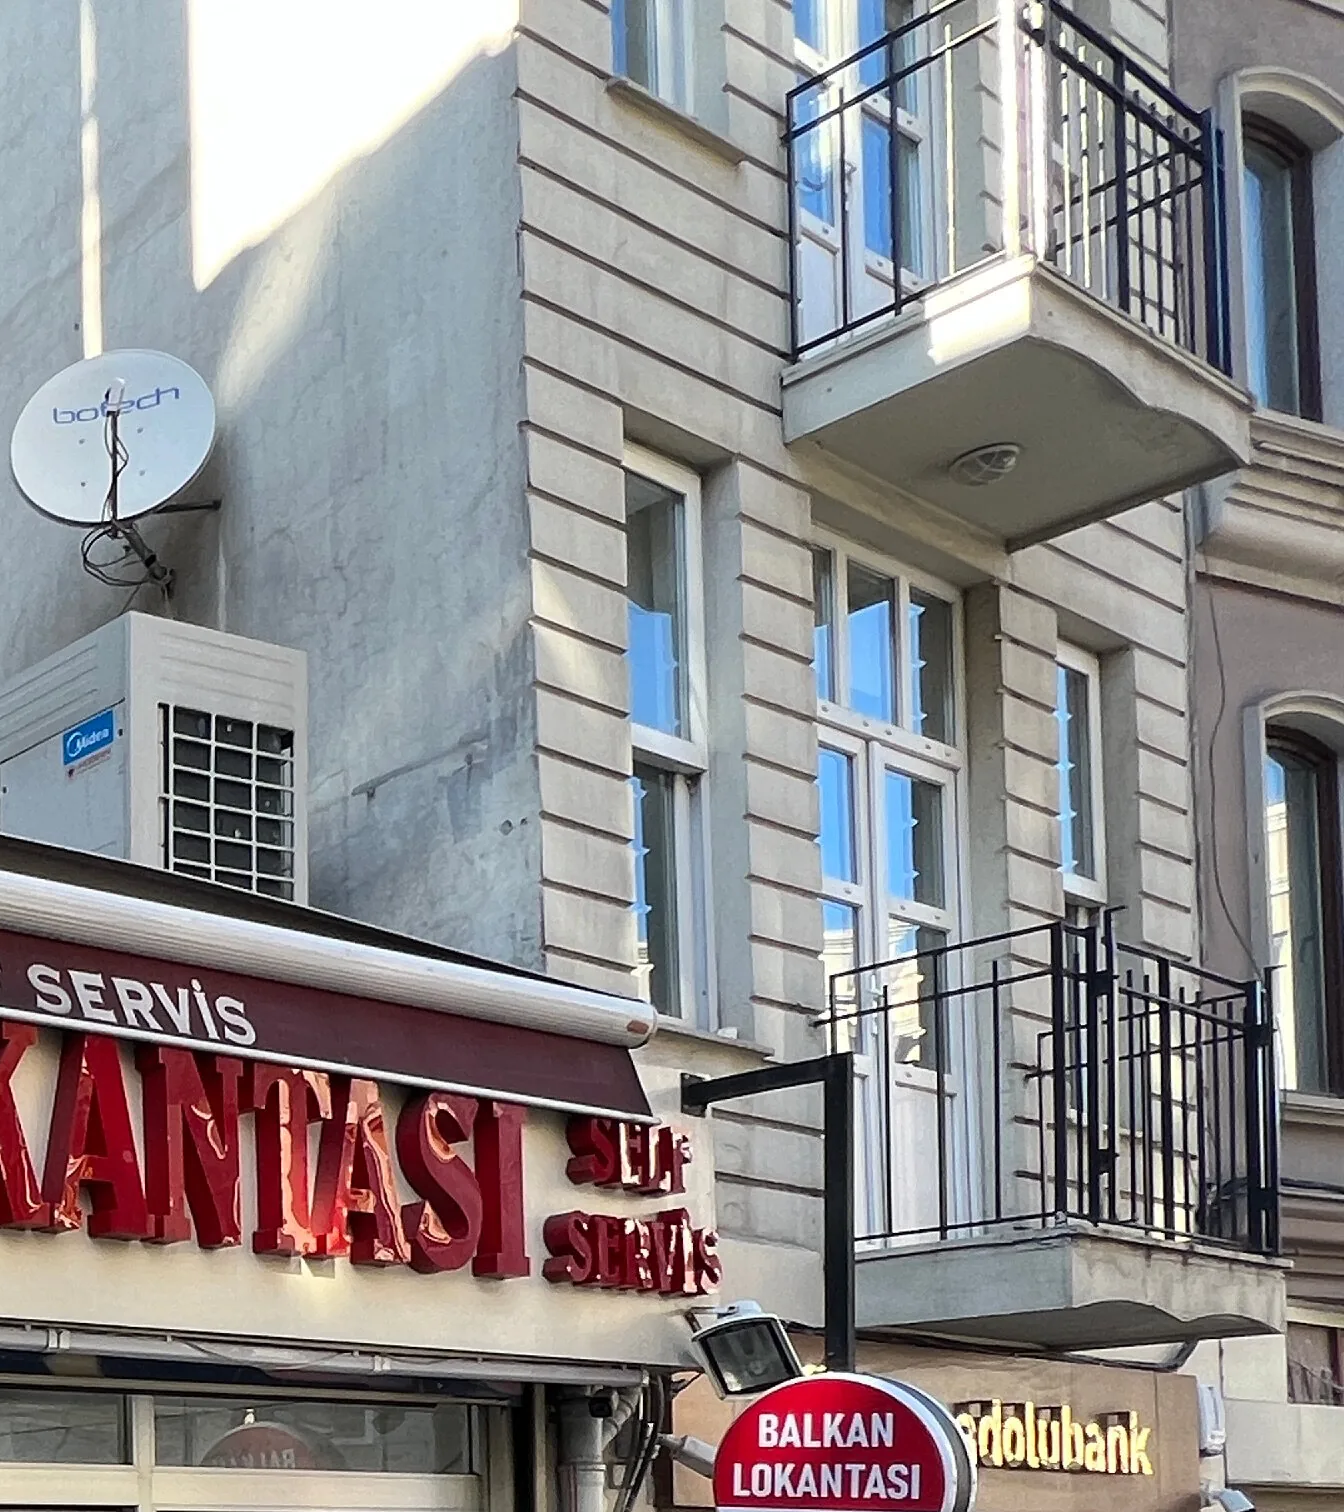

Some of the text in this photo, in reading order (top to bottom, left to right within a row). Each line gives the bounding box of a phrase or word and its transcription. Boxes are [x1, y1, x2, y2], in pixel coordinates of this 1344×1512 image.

[27, 963, 257, 1047] SERVİS
[564, 1117, 694, 1197] SELF
[541, 1207, 725, 1298] SERVİS
[758, 1412, 894, 1449] BALKAN
[733, 1463, 921, 1500] LOKANTASI
